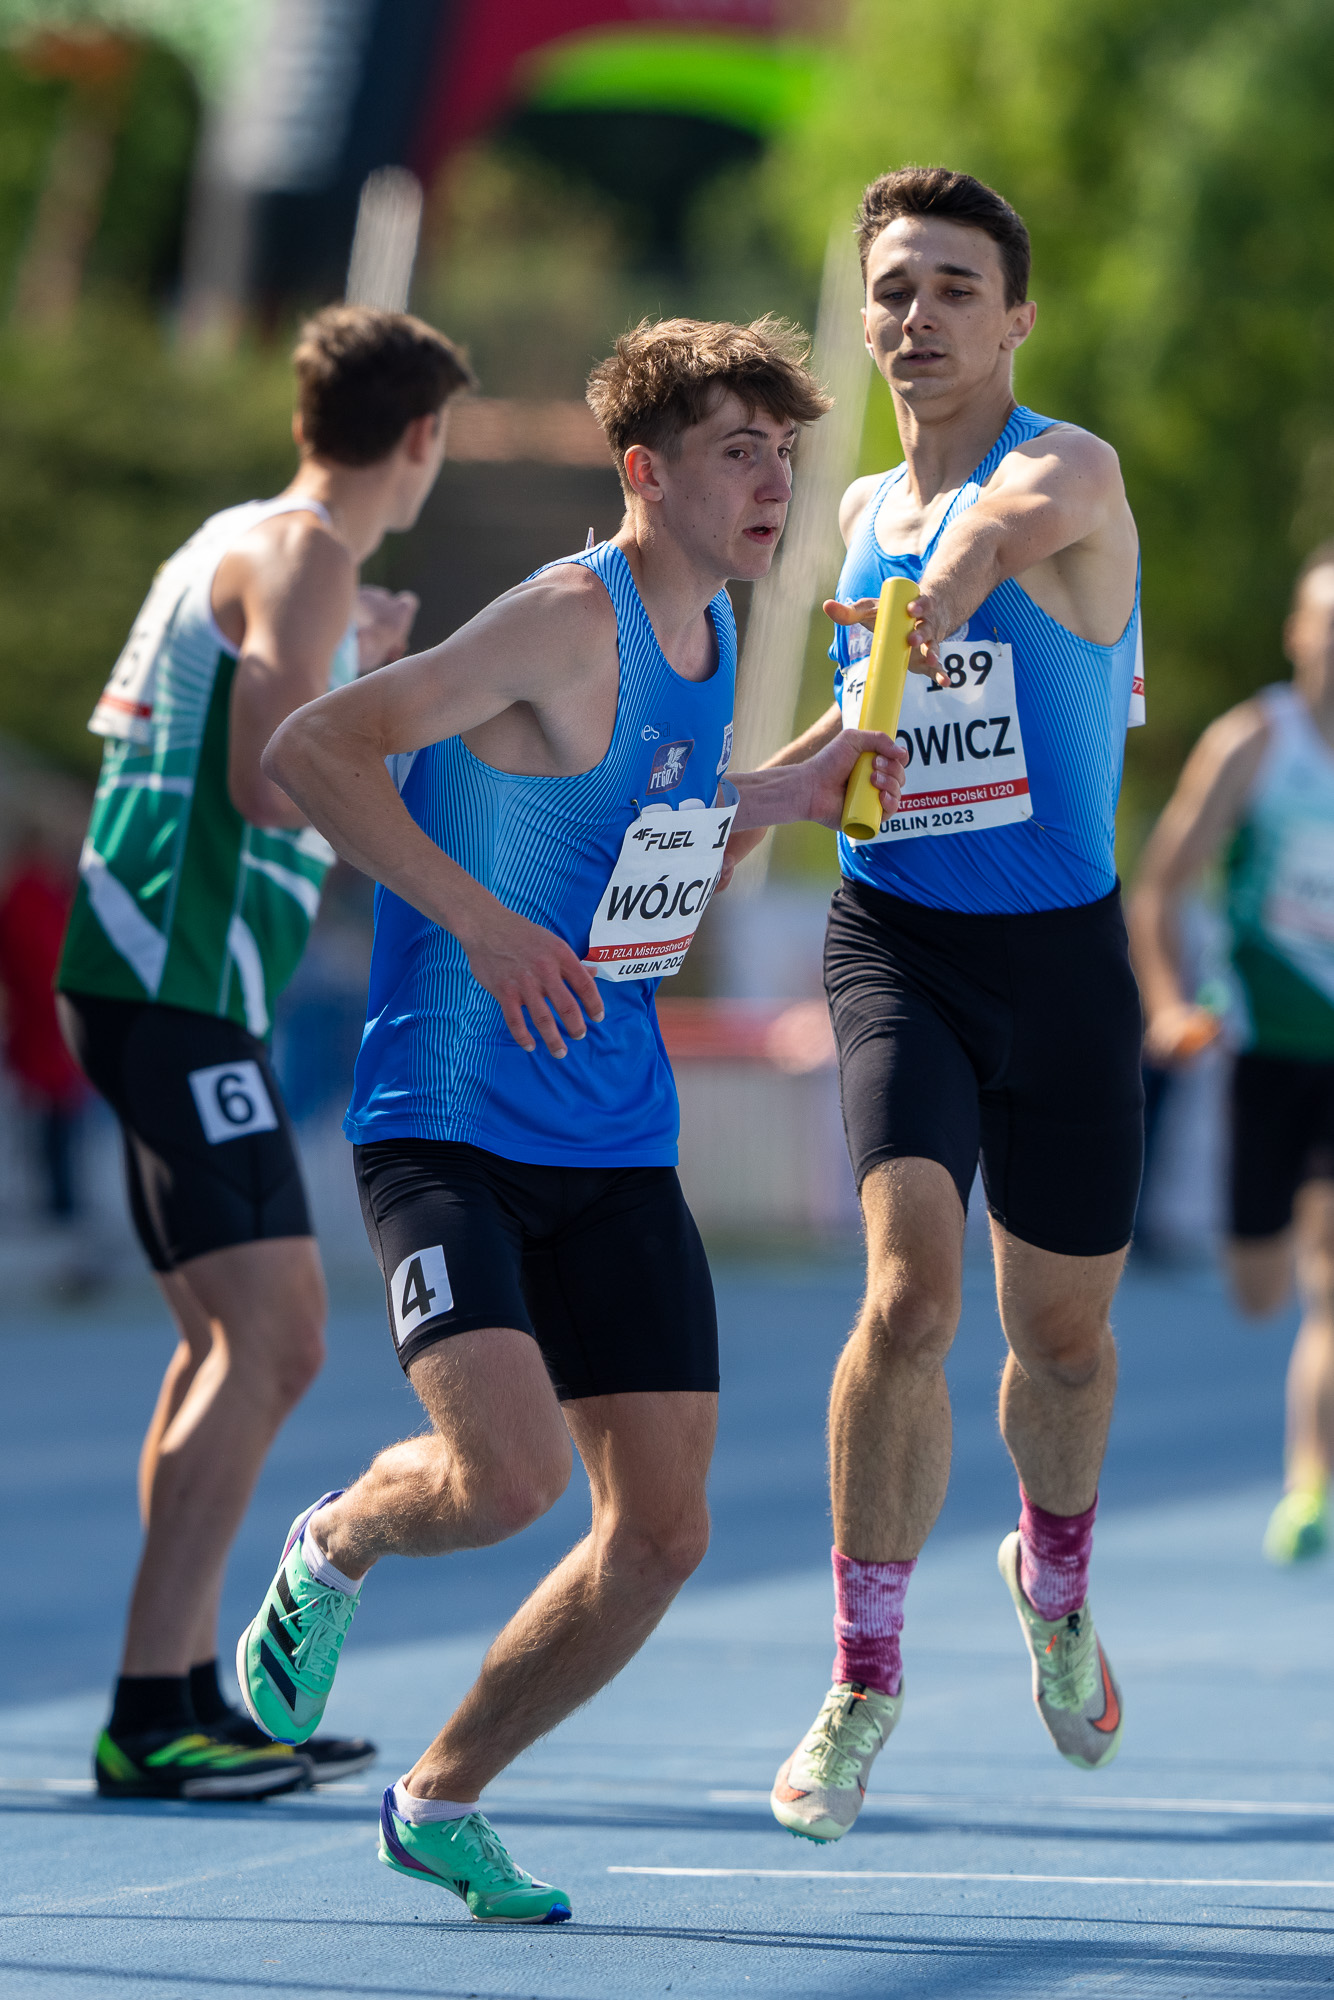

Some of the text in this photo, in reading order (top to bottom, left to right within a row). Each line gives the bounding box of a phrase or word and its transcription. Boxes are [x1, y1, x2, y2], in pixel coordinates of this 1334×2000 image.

[951, 787, 988, 803] Polski
[990, 783, 1015, 797] U20
[931, 809, 975, 827] 2023
[644, 830, 695, 852] FUEL
[711, 816, 732, 849] 1
[612, 946, 632, 959] PZLA
[634, 941, 684, 957] Mistrzostwa
[617, 960, 662, 976] LUBLIN
[216, 1072, 256, 1125] 6
[401, 1255, 437, 1321] 4
